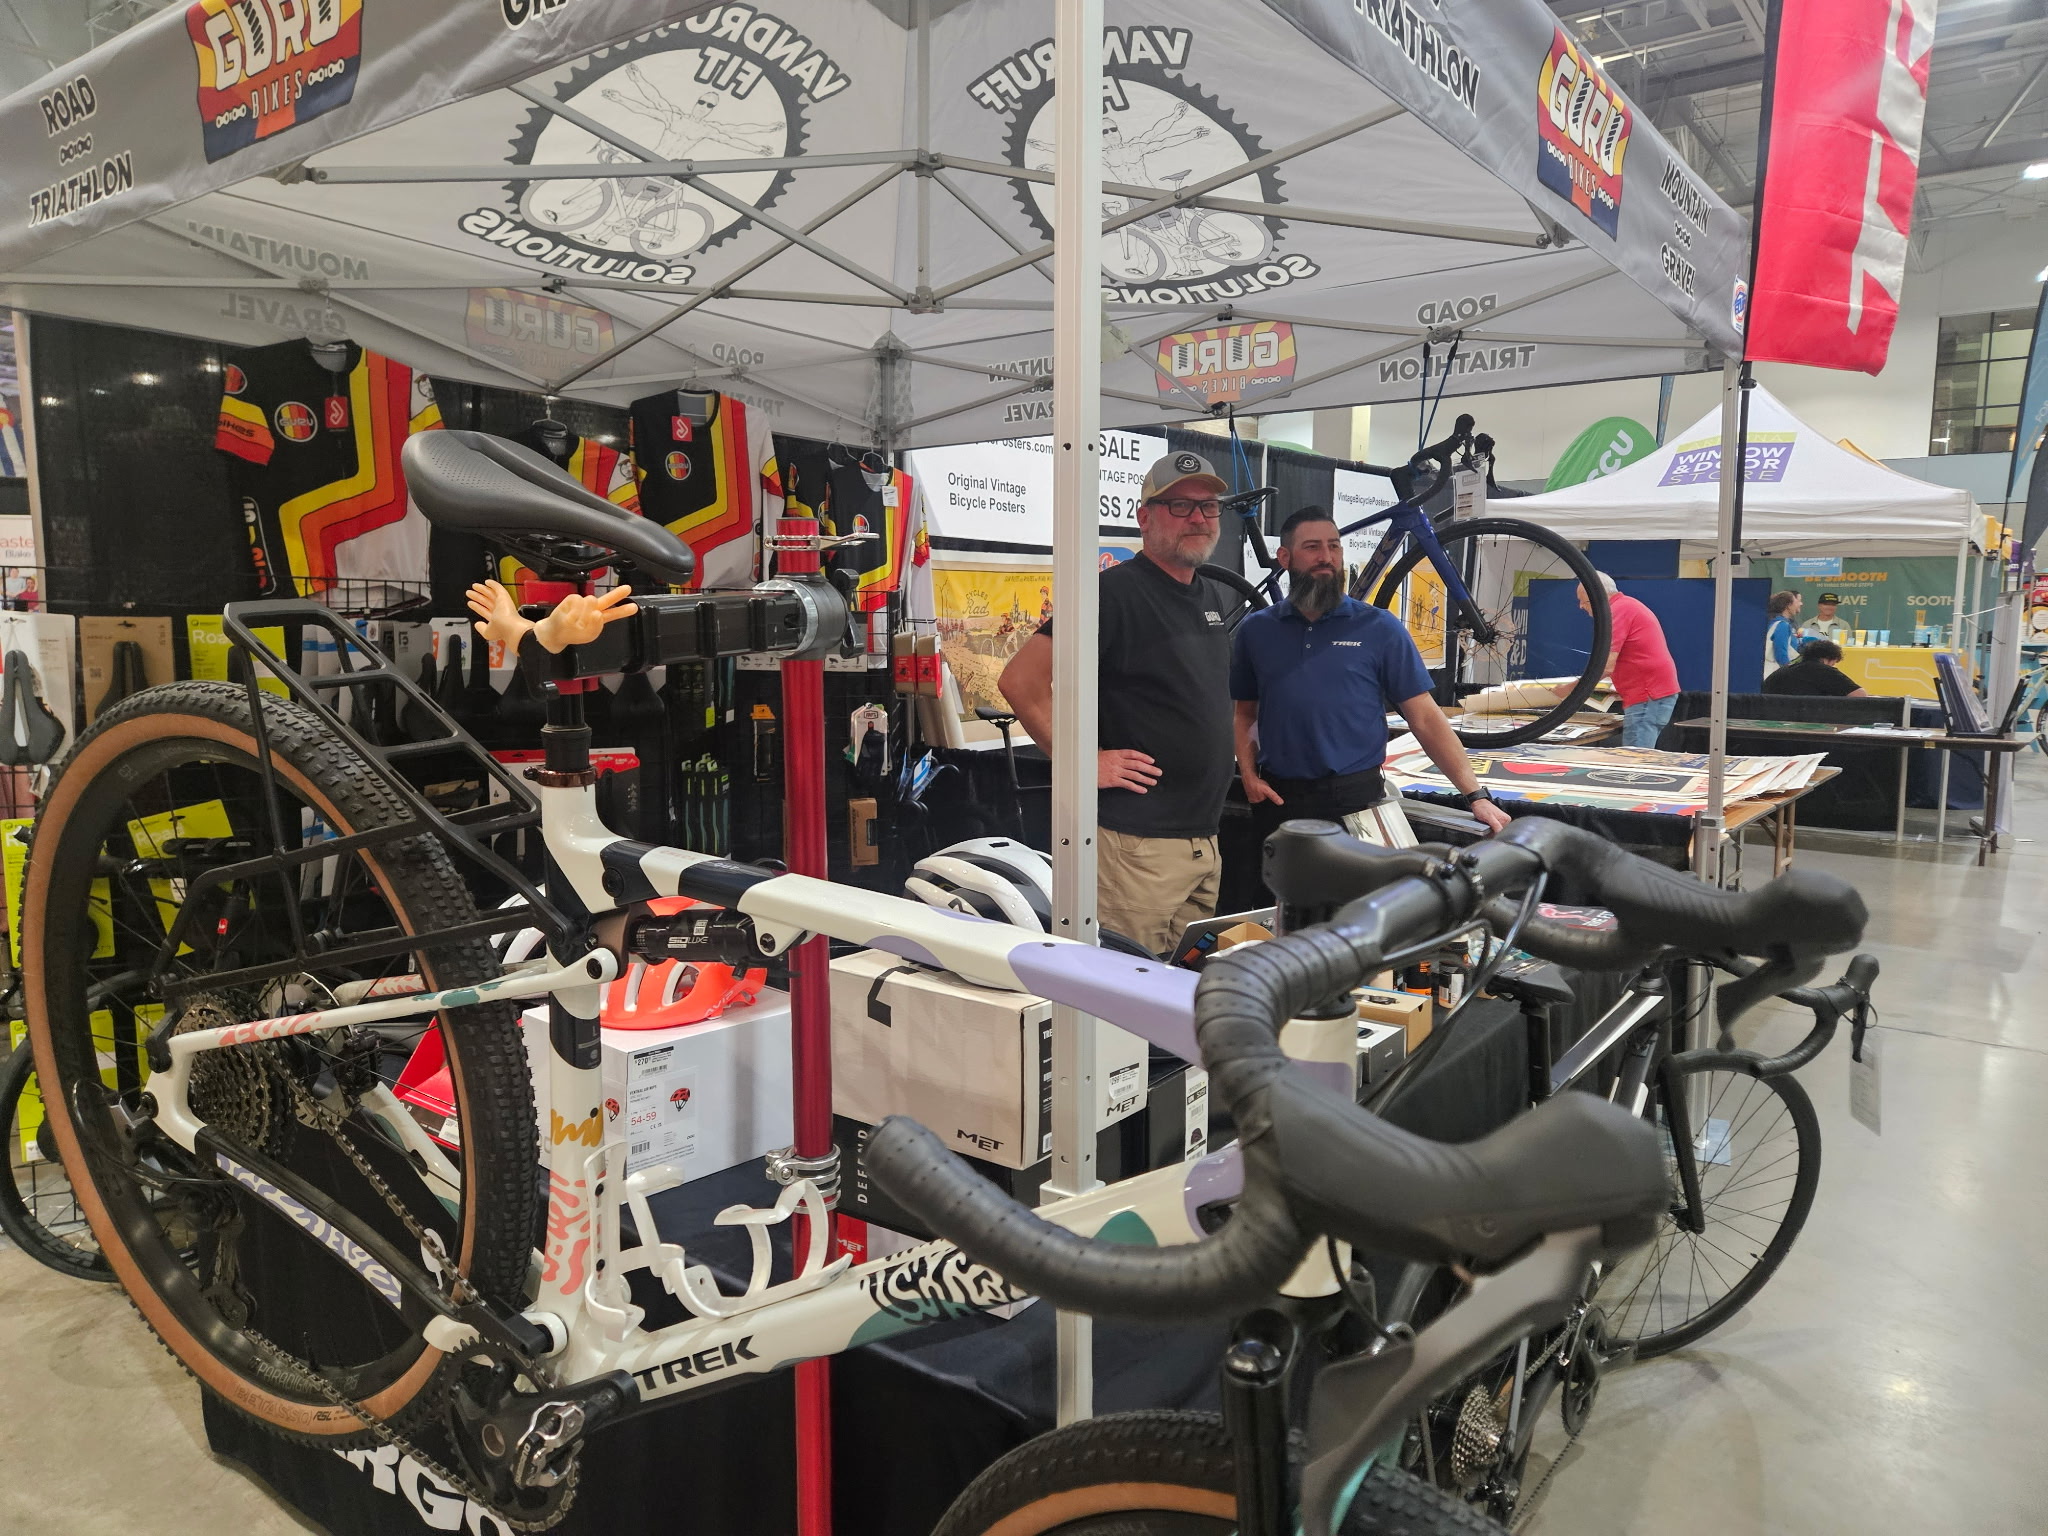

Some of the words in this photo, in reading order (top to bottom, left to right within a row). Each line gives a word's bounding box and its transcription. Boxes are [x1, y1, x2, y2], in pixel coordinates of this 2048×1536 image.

[40, 75, 97, 137] ROAD
[251, 69, 302, 119] BIKES
[1549, 53, 1626, 177] GURU
[28, 150, 135, 228] TRIATHLON
[1568, 153, 1597, 200] BIKES
[1659, 154, 1712, 236] MOUNTAIN
[1661, 242, 1696, 301] GRAVEL
[948, 472, 988, 491] Original
[990, 478, 1026, 497] Vintage
[1672, 464, 1691, 476] &
[949, 492, 986, 511] Bicycle
[989, 497, 1026, 514] Posters
[631, 1111, 657, 1126] 54-59
[1106, 1095, 1139, 1117] MET
[956, 1129, 1004, 1151] MET
[632, 1335, 760, 1390] TREK
